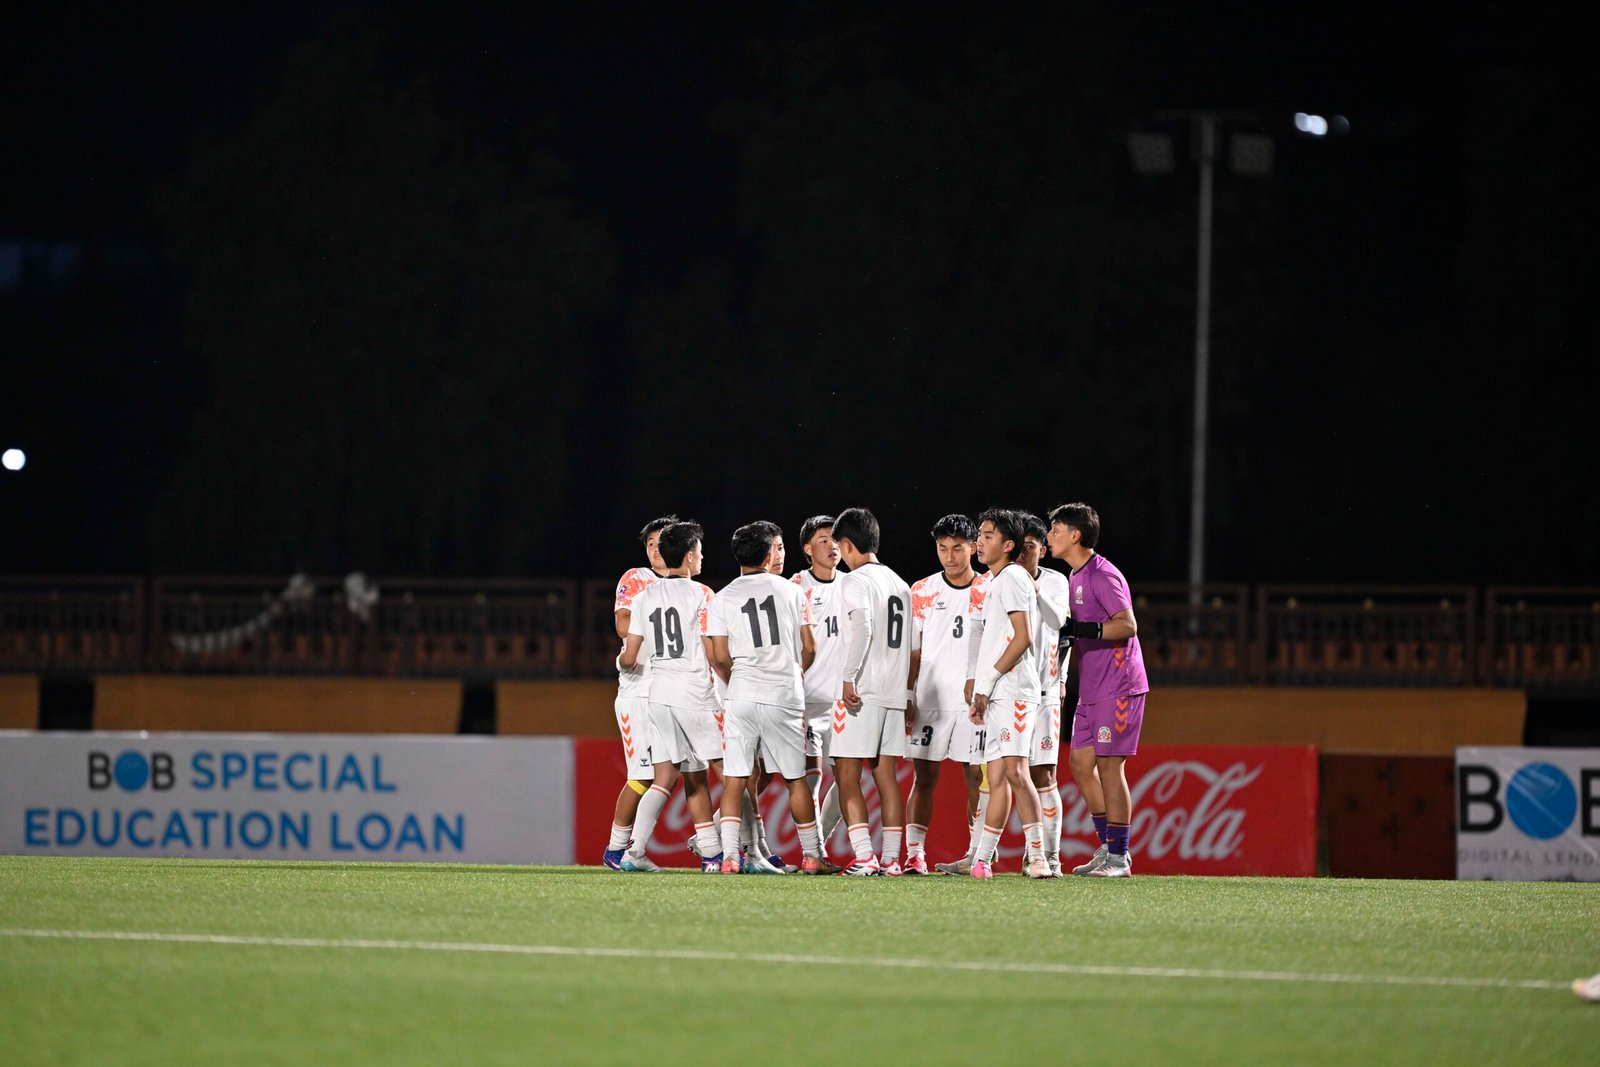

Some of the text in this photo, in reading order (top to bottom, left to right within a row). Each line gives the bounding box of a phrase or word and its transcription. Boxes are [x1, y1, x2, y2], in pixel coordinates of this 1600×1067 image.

[648, 606, 685, 658] 19
[740, 594, 781, 648] 11
[824, 615, 839, 638] 14
[885, 595, 904, 649] 6
[952, 615, 964, 639] 3
[921, 725, 934, 746] 3
[88, 751, 397, 792] BOB SPECIAL
[24, 808, 466, 852] EDUCATION LOAN
[1460, 848, 1532, 864] DIGITAL
